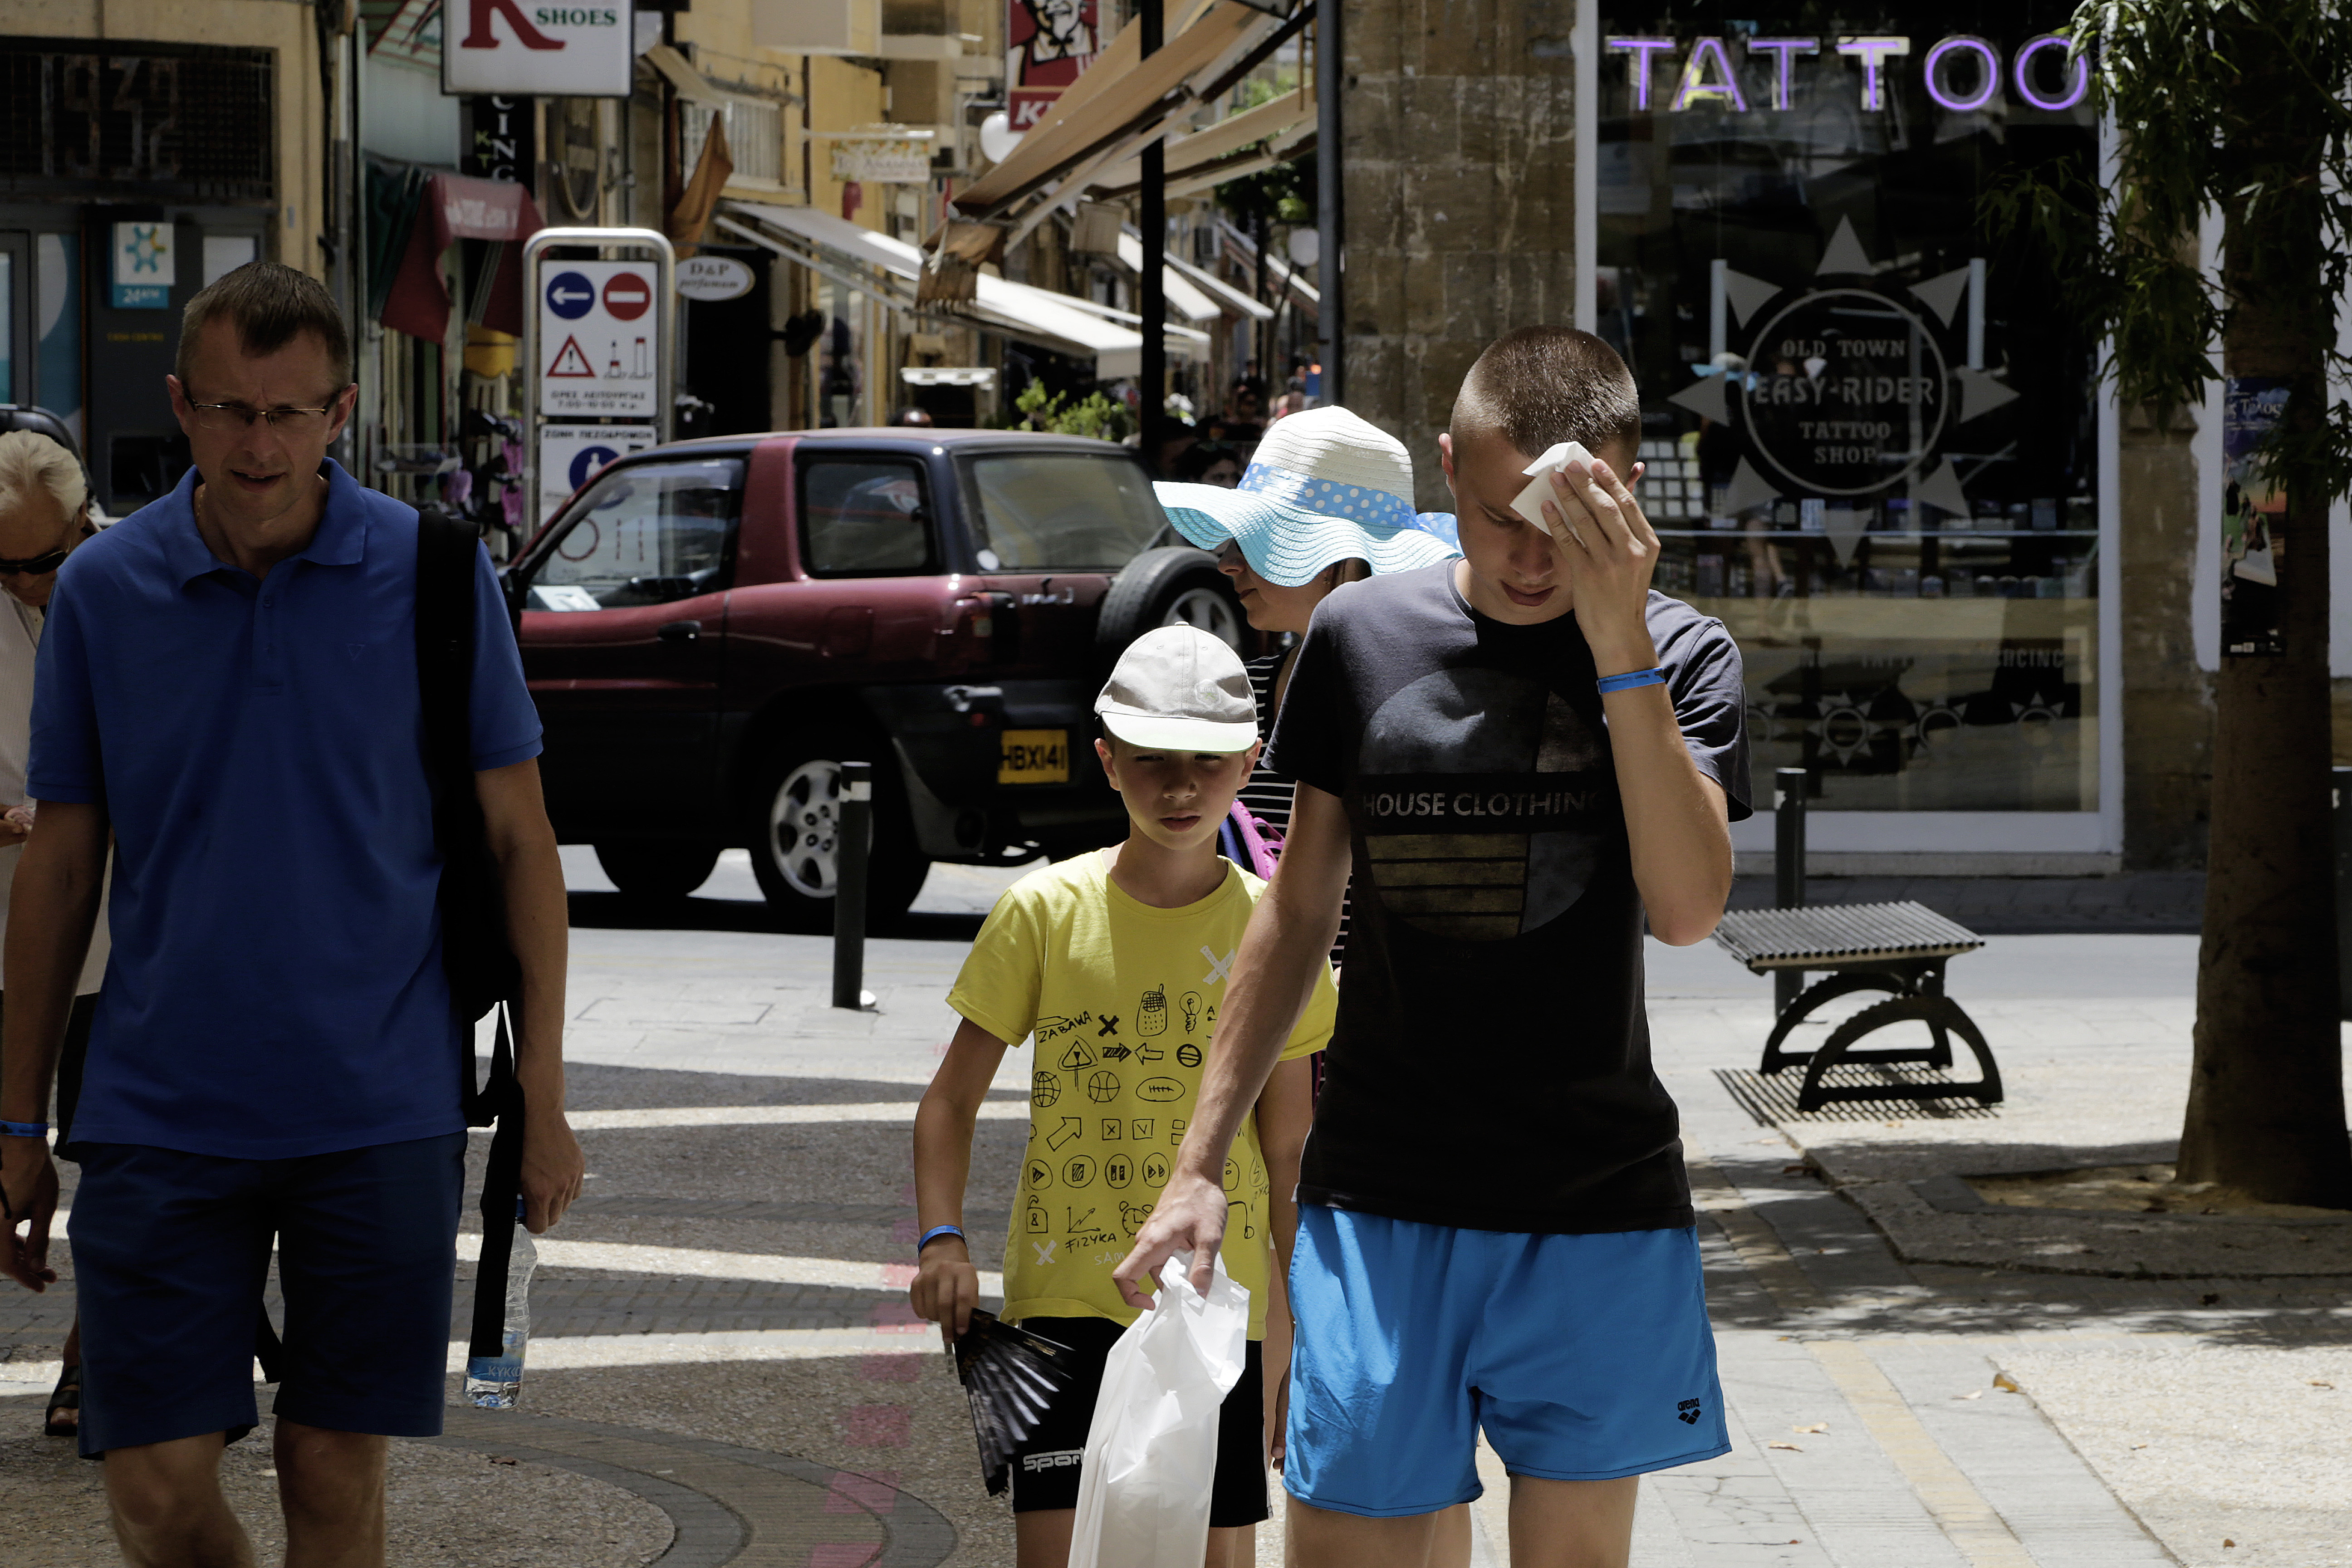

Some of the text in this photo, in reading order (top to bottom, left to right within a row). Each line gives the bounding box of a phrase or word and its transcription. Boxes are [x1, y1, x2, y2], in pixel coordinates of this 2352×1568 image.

[536, 7, 617, 26] SHOES
[1605, 34, 2090, 112] TATTOO
[1780, 339, 1906, 358] OLD TOWN
[1754, 376, 1935, 406] EASY-RIDER
[1798, 421, 1892, 440] TATTOO
[1814, 446, 1877, 464] SHOP
[1363, 792, 1446, 816] HOUSE
[1039, 1010, 1092, 1043] ZABAWA
[1065, 1233, 1117, 1254] FIZYKA
[1677, 1397, 1700, 1411] arena
